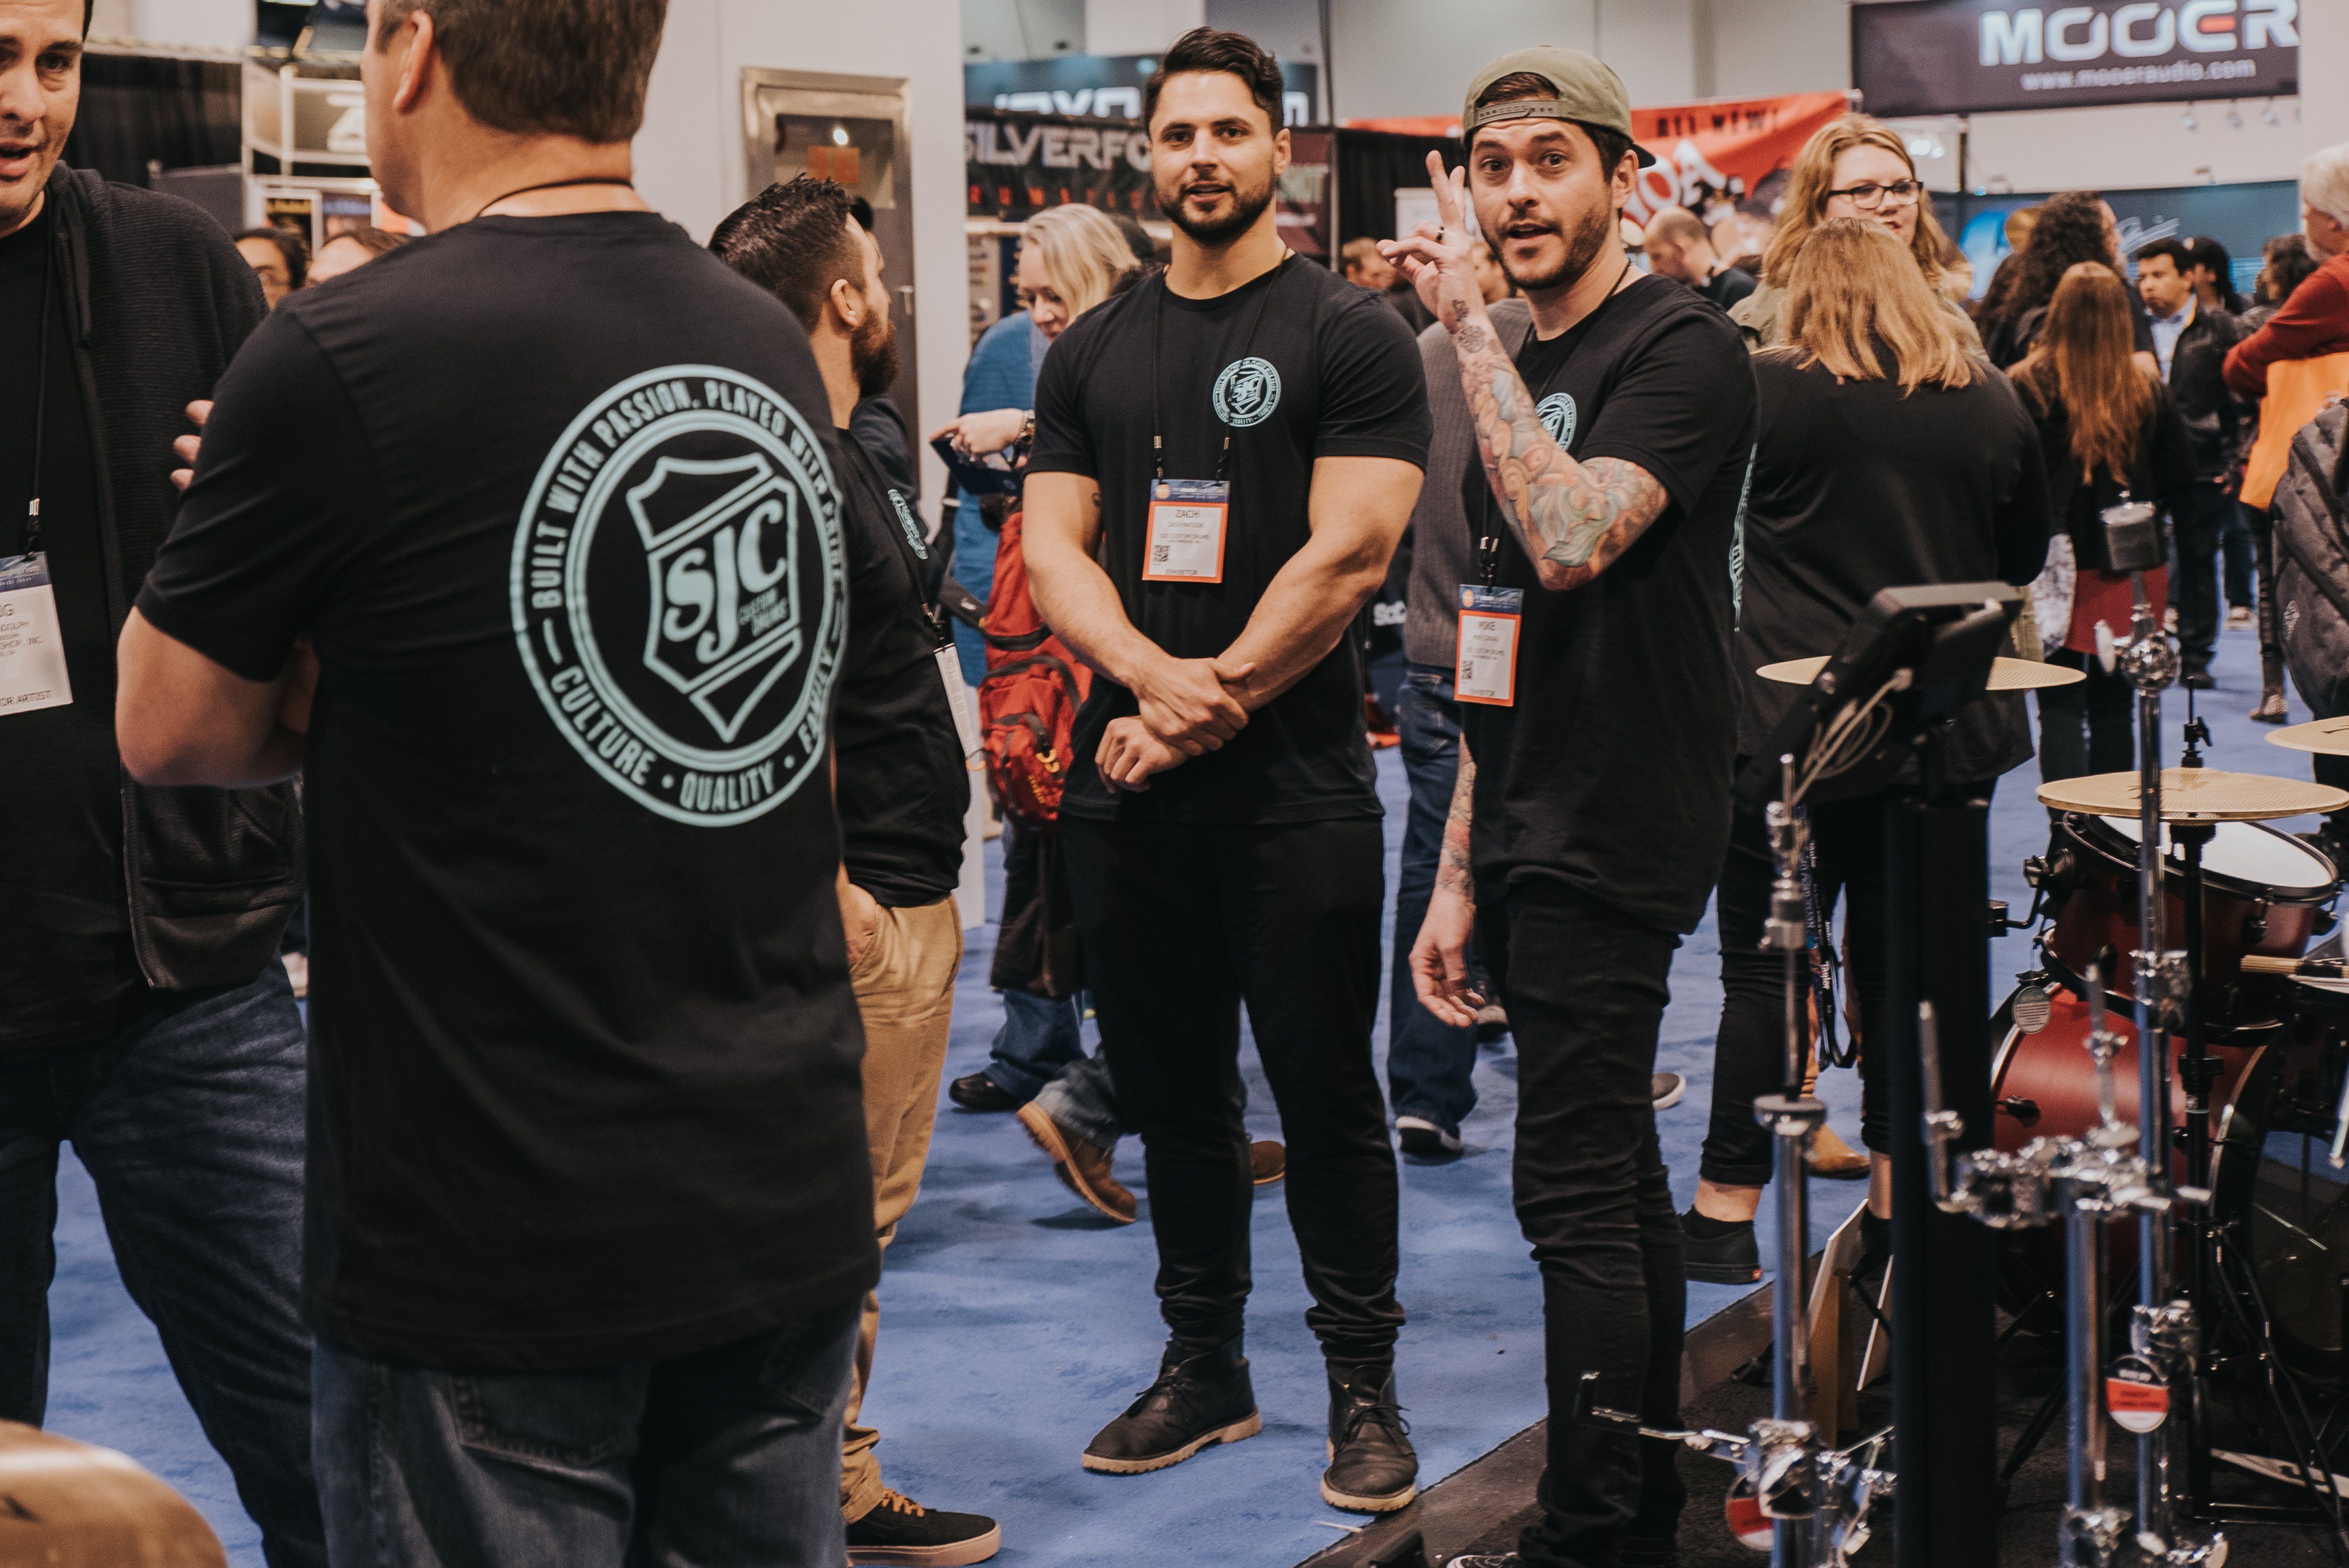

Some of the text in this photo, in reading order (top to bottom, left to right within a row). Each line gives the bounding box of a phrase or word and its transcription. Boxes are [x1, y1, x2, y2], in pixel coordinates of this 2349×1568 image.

[1979, 0, 2299, 66] MOOER
[2021, 59, 2256, 90] www.mooeraudio.com
[592, 380, 701, 448] PASSION.
[704, 380, 786, 437] PLAYED
[545, 441, 604, 513] WITH
[1175, 510, 1200, 518] ZACH
[531, 523, 568, 609] BUILT
[663, 498, 787, 664] SJC
[551, 666, 657, 785] CULTURE
[679, 760, 774, 811] QUALITY
